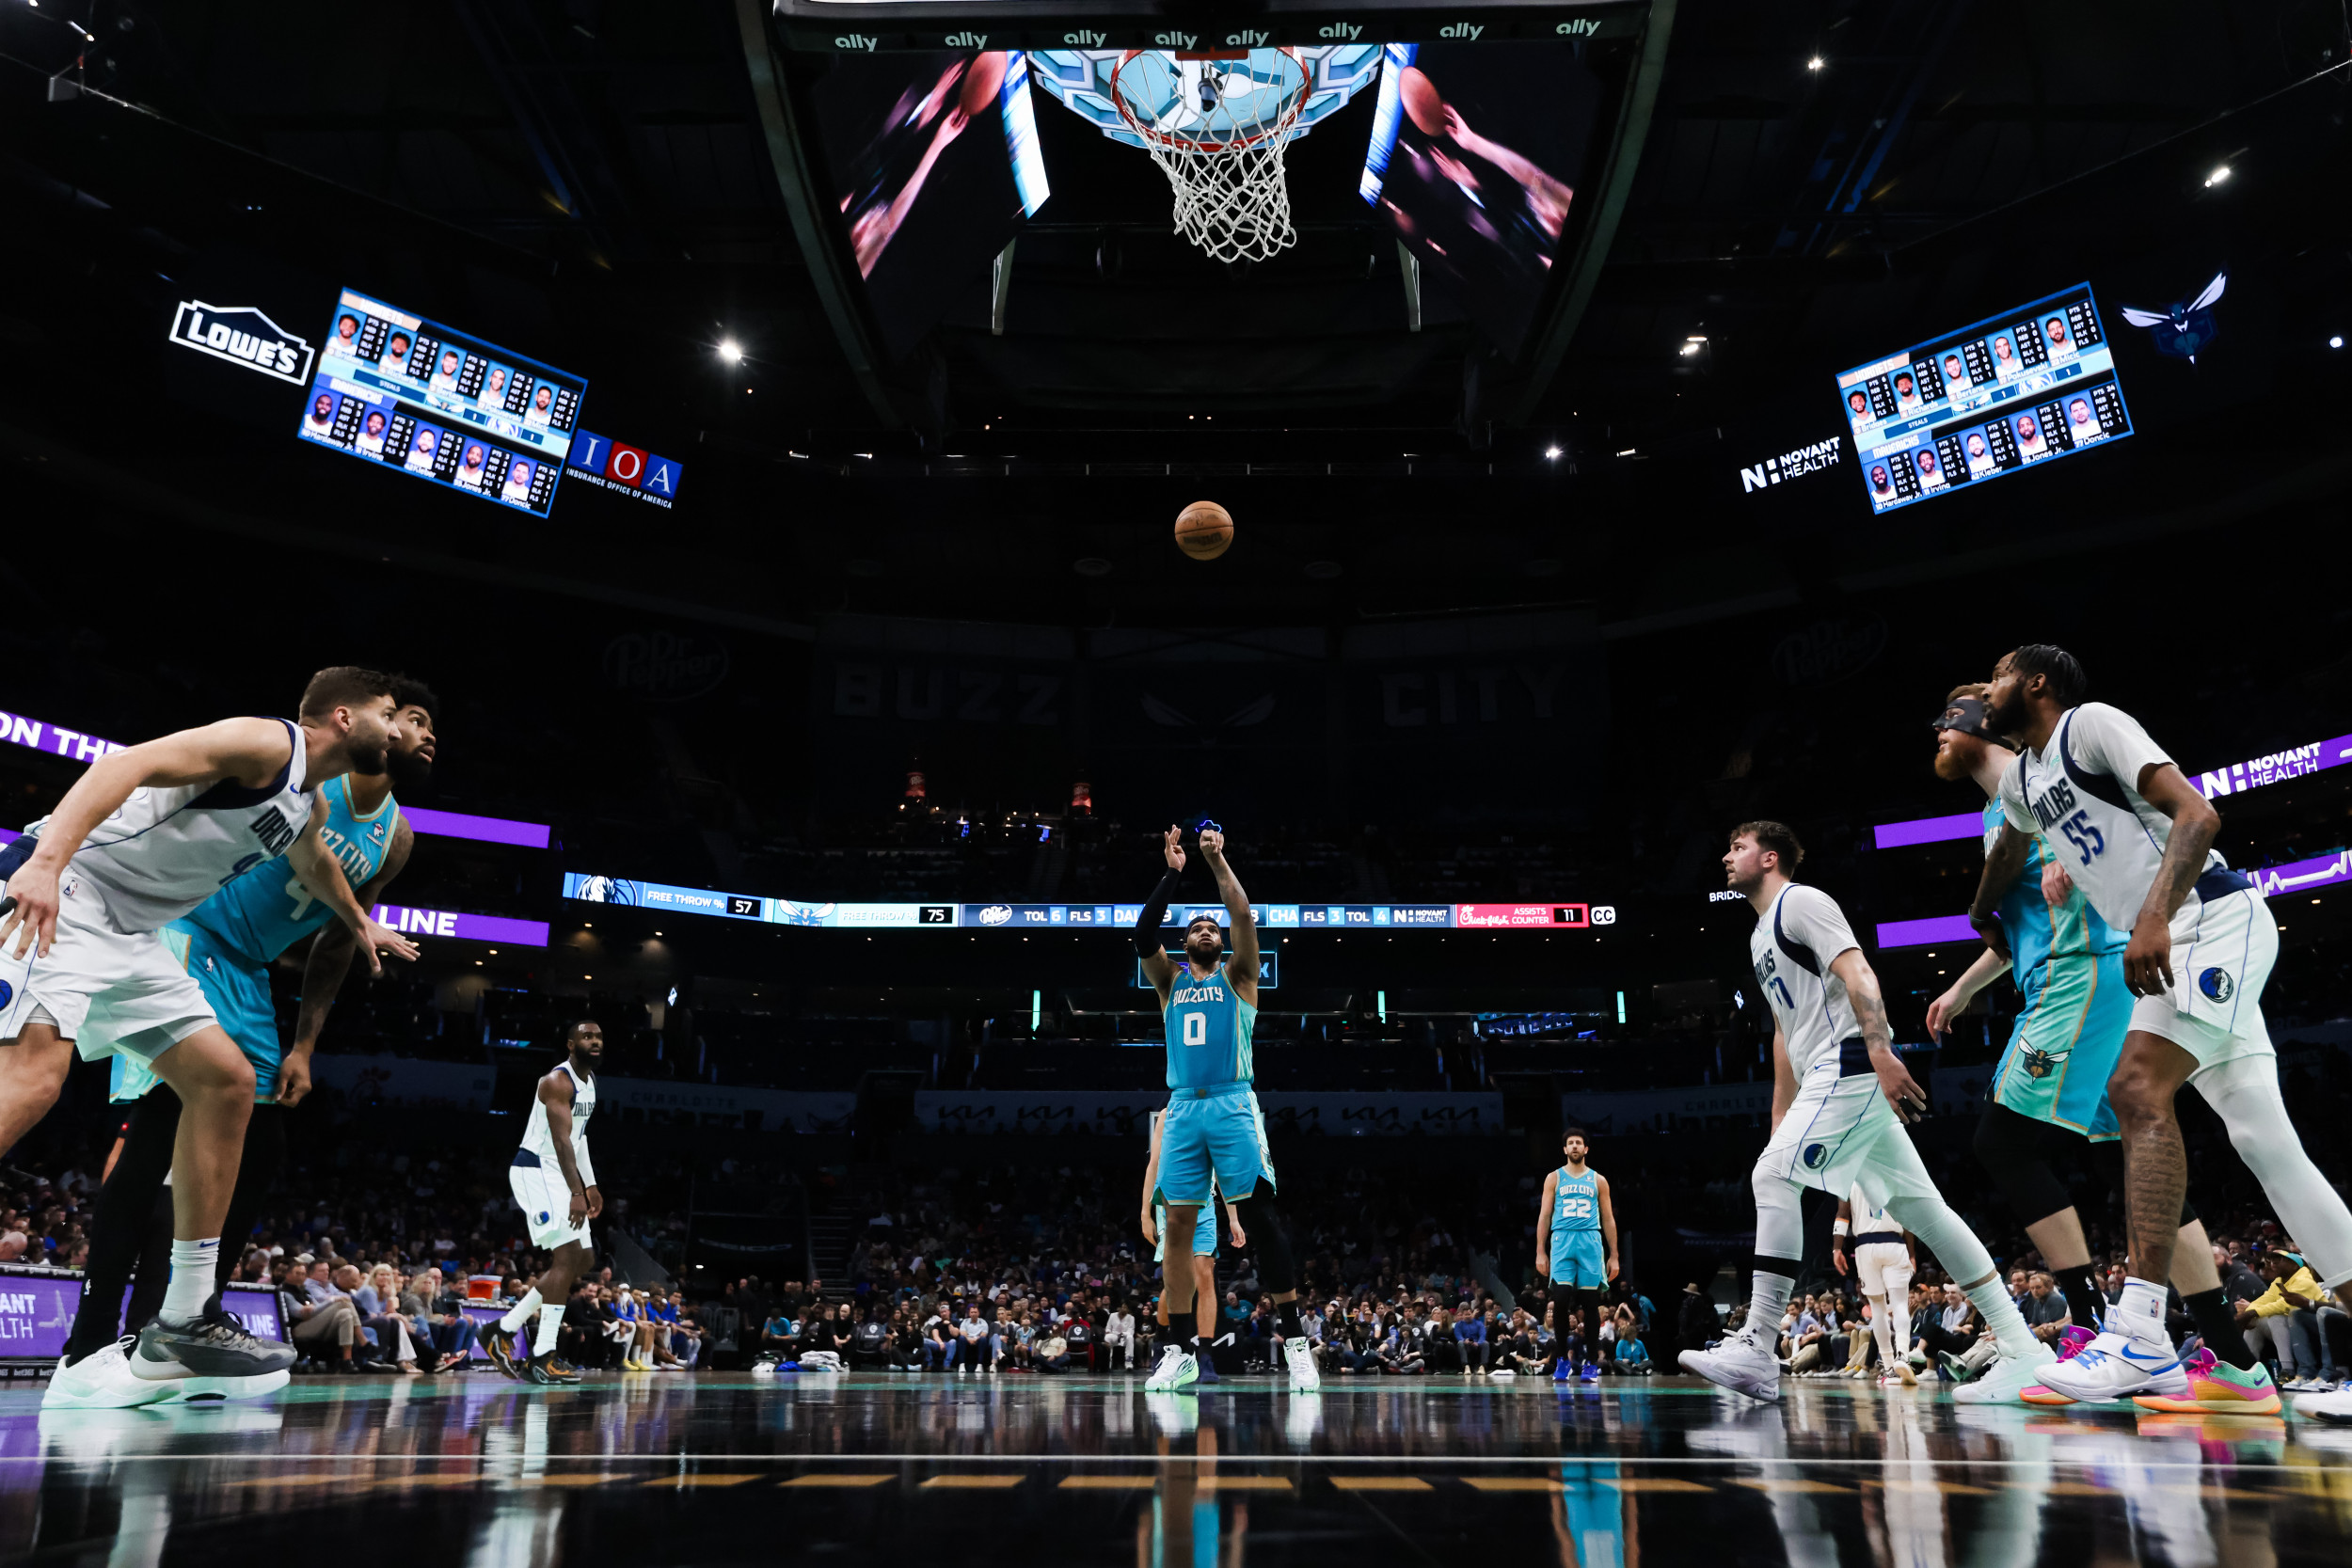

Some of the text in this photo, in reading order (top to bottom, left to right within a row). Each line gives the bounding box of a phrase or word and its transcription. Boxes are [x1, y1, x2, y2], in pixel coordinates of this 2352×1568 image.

[1318, 23, 1363, 40] ally
[1439, 23, 1485, 40] ally
[1555, 19, 1600, 37] ally
[835, 34, 878, 52] ally
[945, 32, 988, 50] ally
[1063, 29, 1106, 47] ally
[1154, 31, 1198, 50] ally
[1226, 29, 1269, 47] ally
[187, 311, 298, 374] LOWE'S
[1854, 358, 1895, 383] HORNETS
[378, 379, 400, 392] STEALS
[1907, 417, 1928, 429] STEALS
[1872, 434, 1920, 459] MAVERICKS
[2083, 430, 2110, 445] Doncic
[1779, 436, 1840, 467] NOVANT
[2029, 449, 2053, 462] Jones
[1783, 451, 1839, 480] HEALTH
[1979, 464, 2003, 478] Kleber
[566, 467, 673, 509] INSURANCE OFFICE OF AMERICA
[834, 661, 1064, 725] BUZZ
[1377, 661, 1569, 728] CITY
[2249, 742, 2321, 773] NOVANT
[2250, 758, 2318, 788] HEALTH
[2060, 809, 2105, 866] 55
[647, 891, 725, 910] FREE THROW %
[1708, 890, 1747, 902] BRIDG
[735, 899, 753, 914] 57
[928, 909, 945, 922] 75
[1564, 909, 1574, 922] 11
[378, 906, 458, 937] LINE
[843, 911, 866, 921] FREE
[869, 911, 906, 921] THROW
[1024, 910, 1061, 922] TOL 6
[1070, 910, 1105, 922] FLS 3
[1270, 910, 1298, 922] CHA
[1304, 911, 1340, 922] FLS 3
[1346, 911, 1386, 922] TOL 4
[1512, 916, 1549, 925] COUNTER
[1594, 910, 1613, 922] CC
[1769, 976, 1795, 1009] 77
[1184, 1012, 1206, 1046] 0
[1559, 1184, 1595, 1197] BUZZ CITY
[1563, 1198, 1591, 1218] 22
